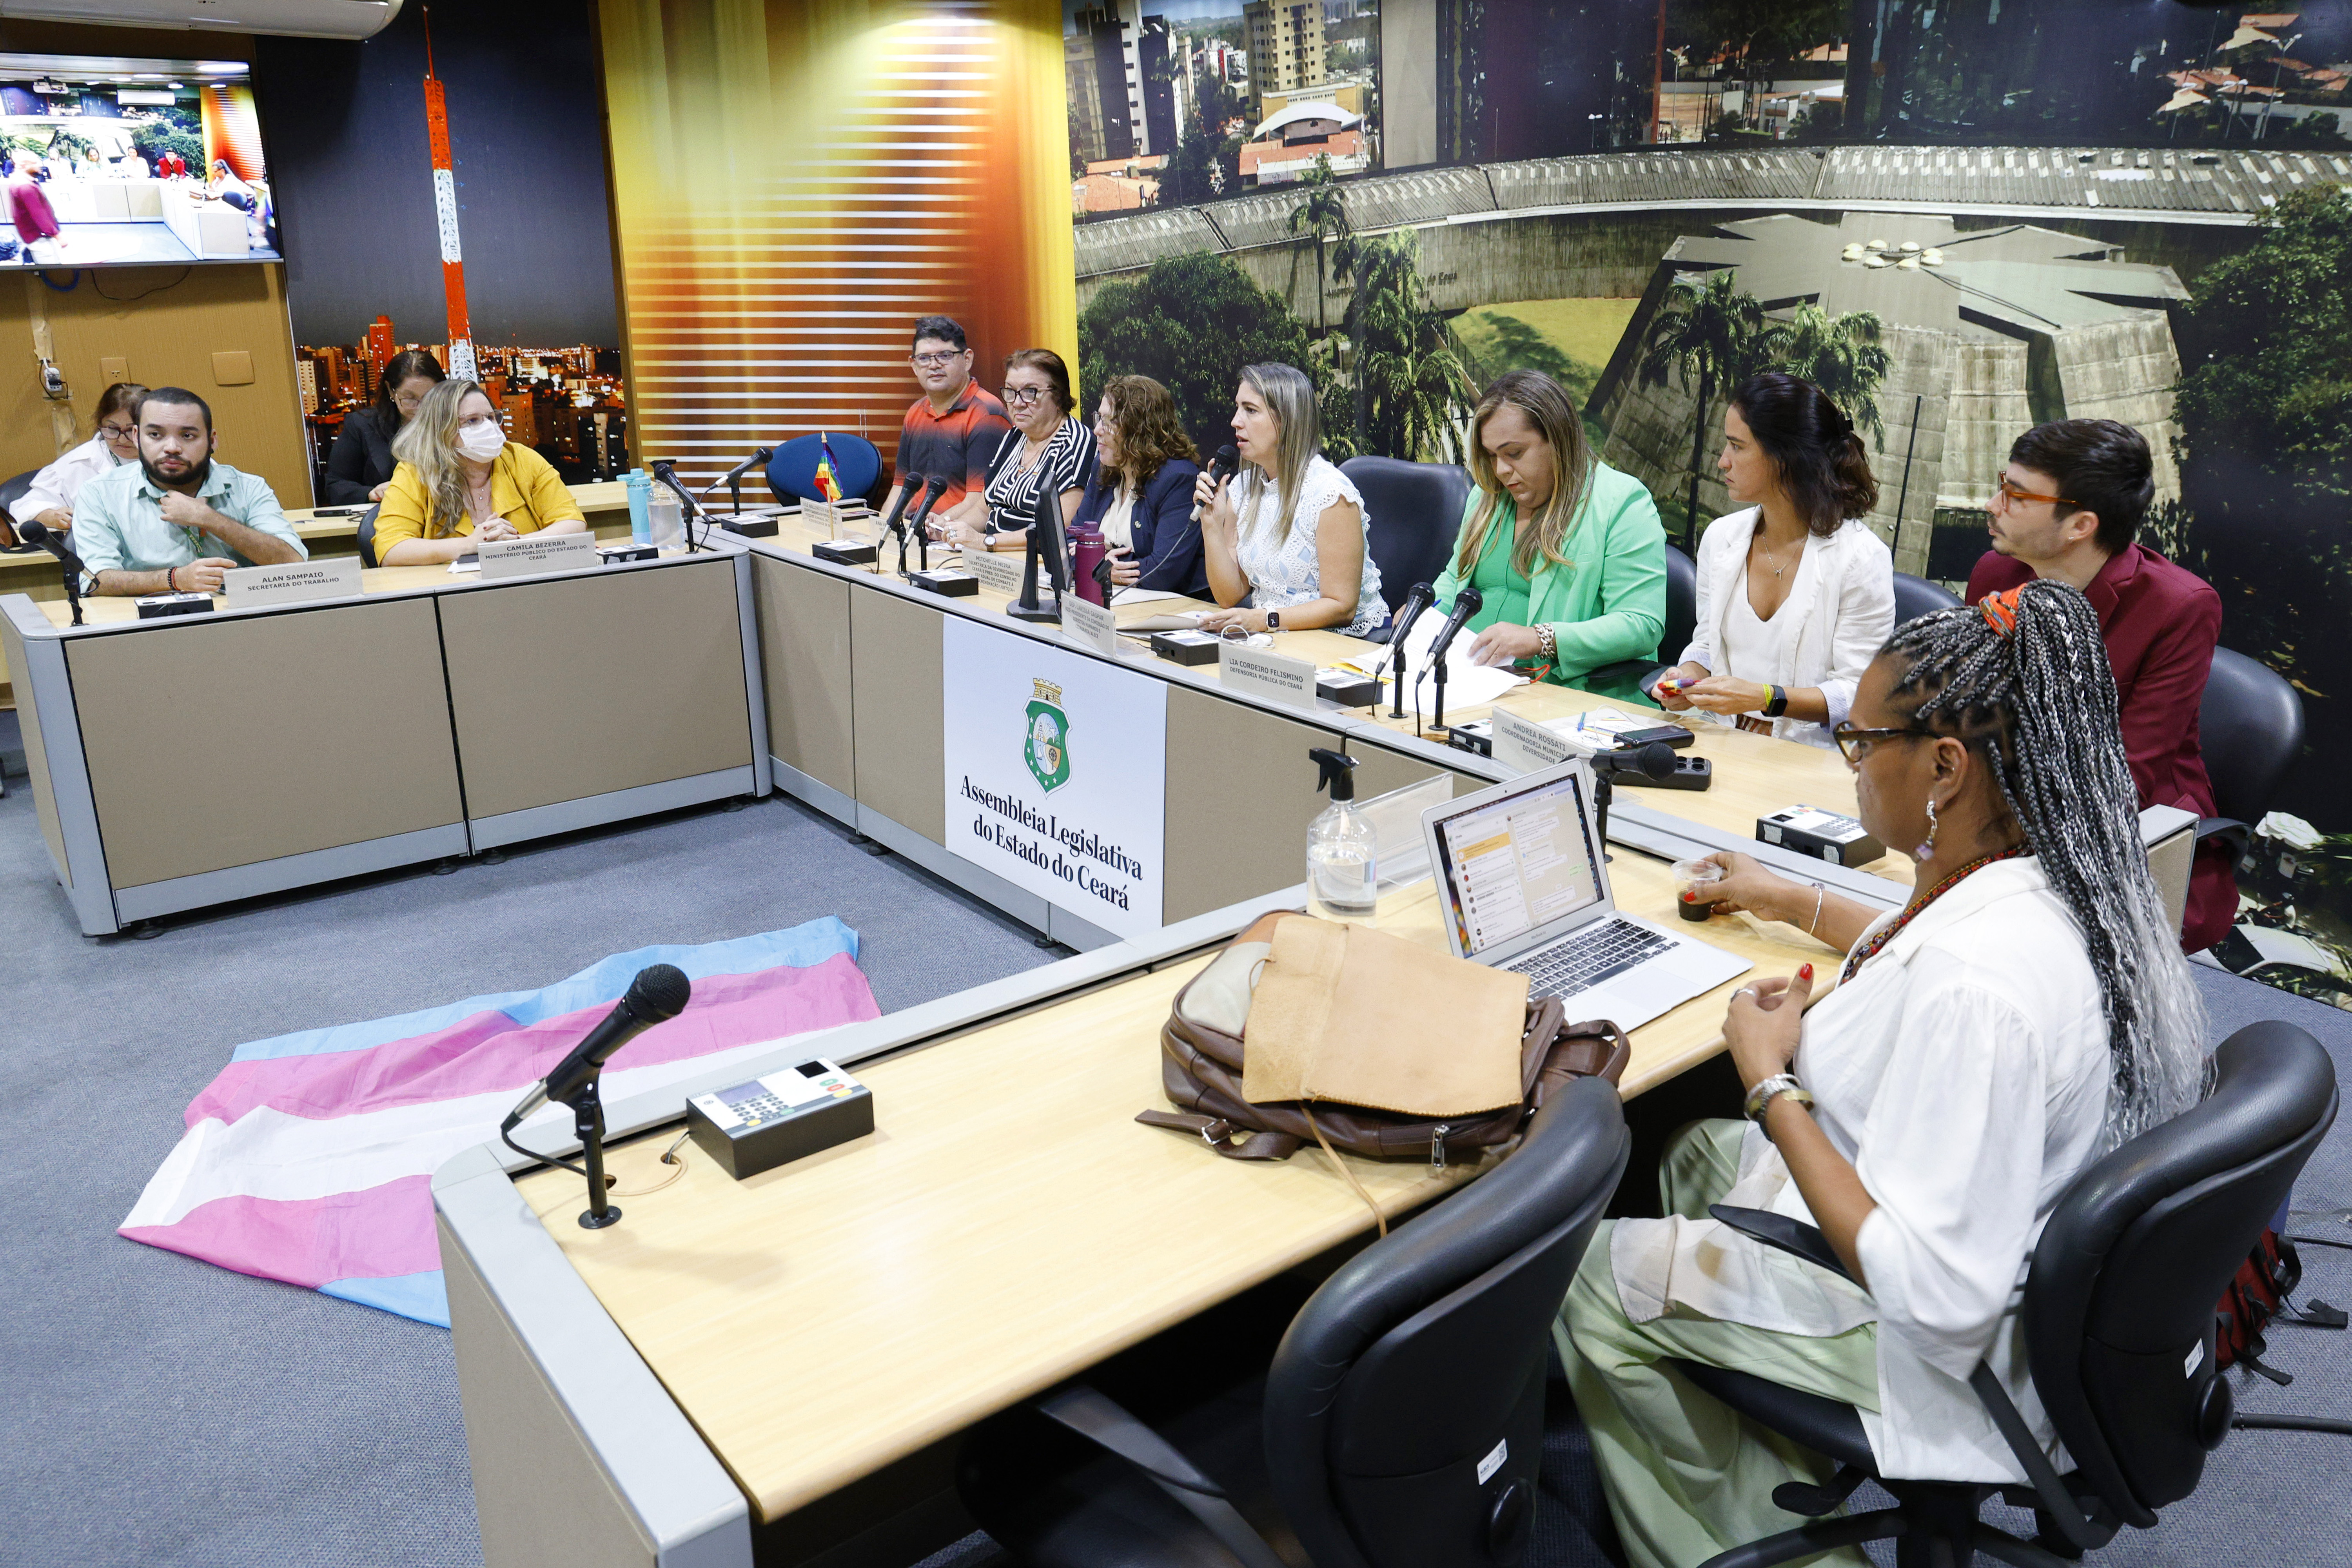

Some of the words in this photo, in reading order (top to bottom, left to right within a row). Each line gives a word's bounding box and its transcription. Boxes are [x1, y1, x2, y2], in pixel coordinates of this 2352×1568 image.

[976, 555, 997, 566] MITCHELLE
[248, 582, 290, 591] SECRETARIA
[286, 572, 323, 581] SAMPAIO
[1000, 574, 1016, 582] CONSELHO
[1230, 667, 1257, 679] DEFENSORIA
[1258, 673, 1278, 684] PÚBLICA
[1287, 682, 1303, 690] CEARÁ
[1240, 661, 1269, 674] CORDEIRO
[1270, 668, 1303, 682] FELISMINO
[1502, 726, 1541, 750] COORDENADORIA
[1513, 723, 1537, 739] ANDREA
[1539, 733, 1566, 751] ROSSATI
[1523, 745, 1555, 765] DIVERSIDADE
[960, 775, 1047, 835] Assembleia
[1049, 815, 1143, 881] Legislativa
[974, 814, 992, 841] do
[995, 823, 1048, 870] Estado
[1052, 853, 1074, 882] do
[1078, 866, 1129, 911] Ceará
